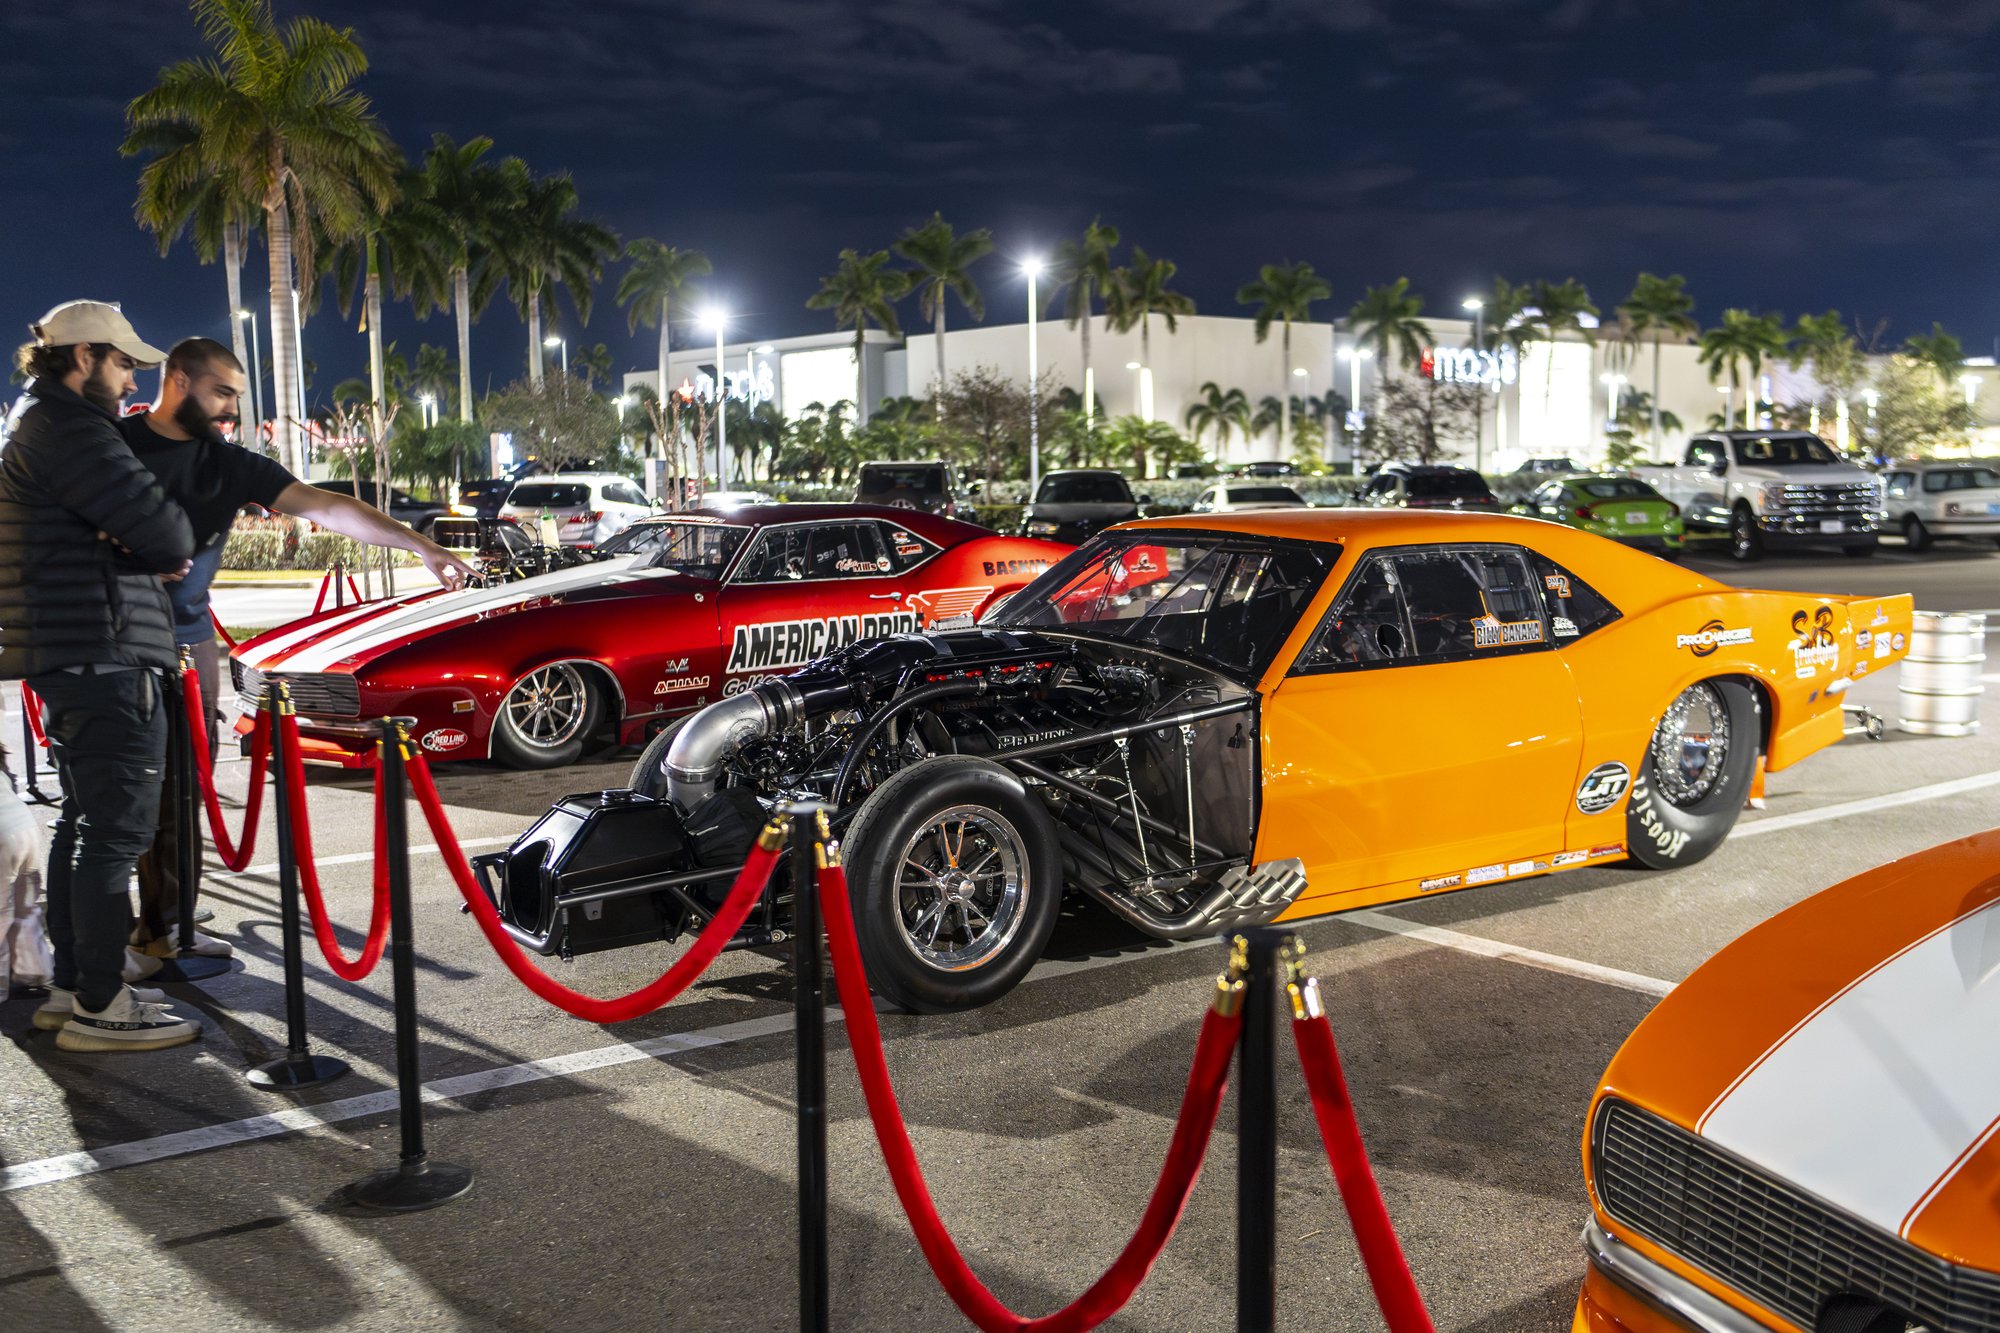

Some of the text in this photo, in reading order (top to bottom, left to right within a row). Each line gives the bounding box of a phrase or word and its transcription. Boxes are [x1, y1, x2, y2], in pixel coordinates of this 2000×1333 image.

[726, 615, 862, 674] AMERICAN
[1475, 625, 1500, 646] BILLY
[1501, 621, 1541, 643] BANAKA
[435, 734, 465, 743] RED LINE
